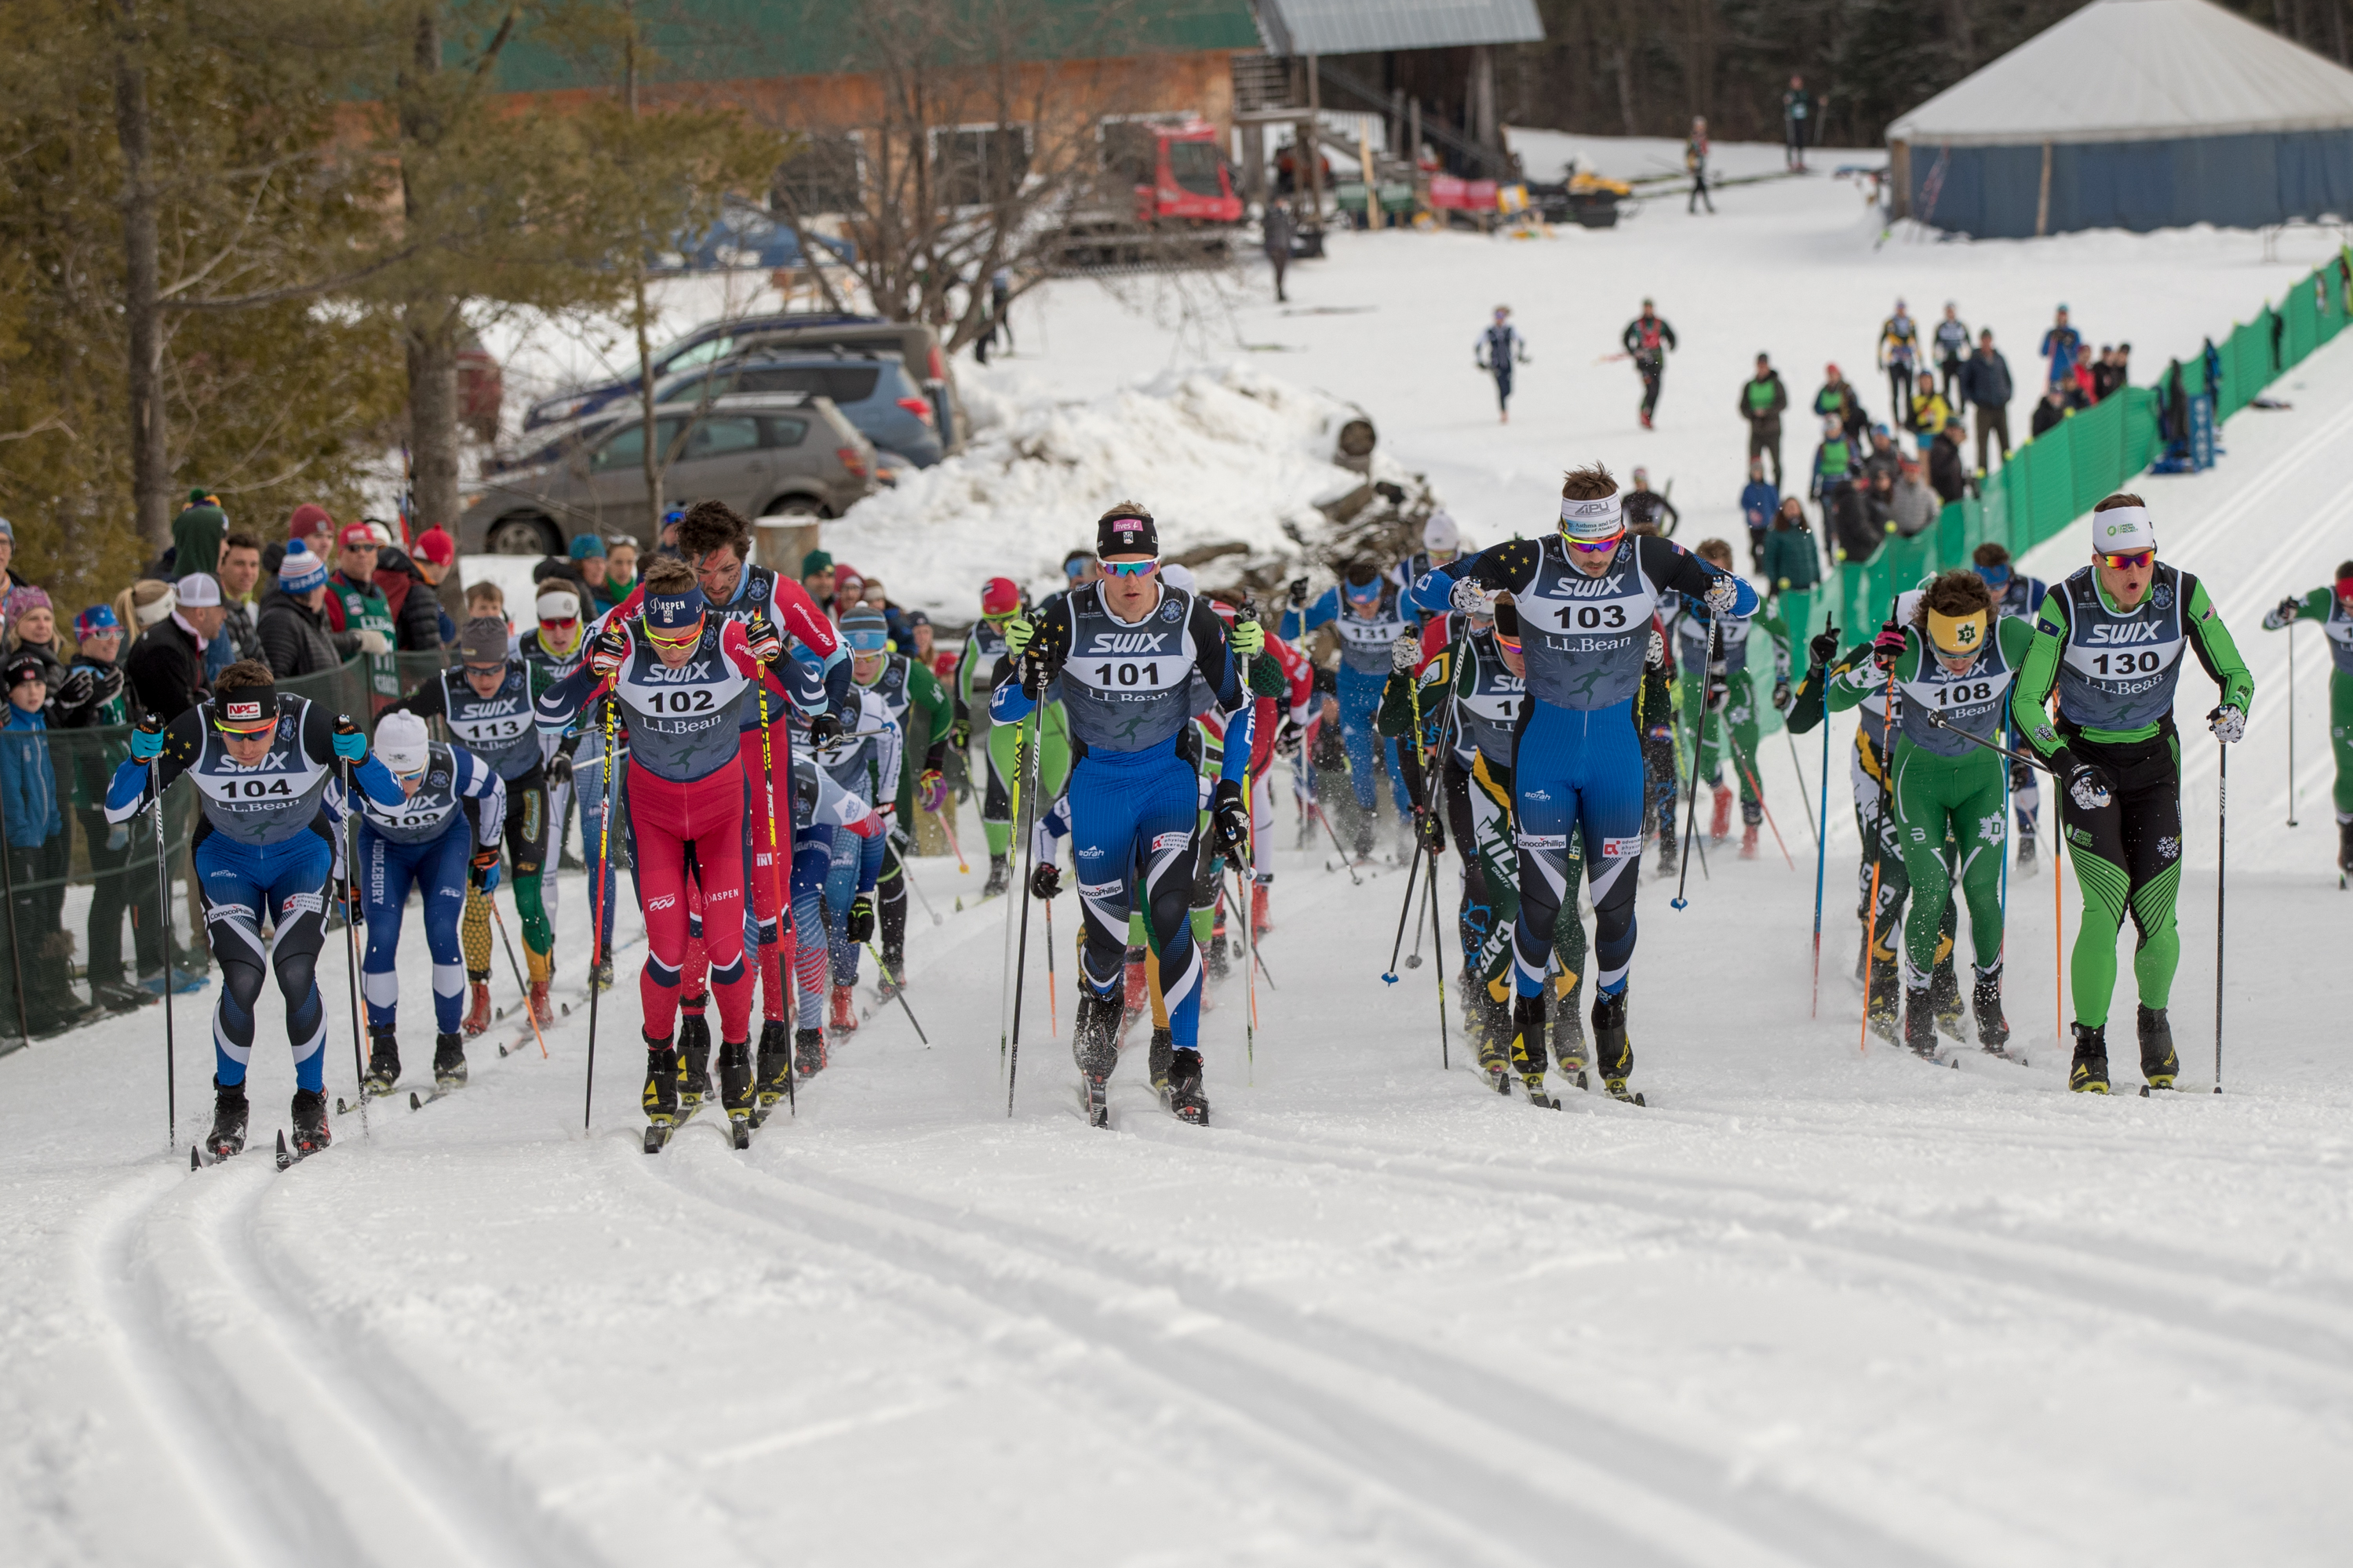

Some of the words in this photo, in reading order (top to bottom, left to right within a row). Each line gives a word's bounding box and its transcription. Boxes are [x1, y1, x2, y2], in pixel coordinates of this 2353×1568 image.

[1550, 573, 1626, 597] SWIX
[661, 600, 686, 610] ASPEN
[792, 602, 821, 635] podiumwear
[1553, 605, 1627, 629] 103
[1087, 632, 1169, 653] SWIX
[1351, 628, 1389, 639] 131
[1707, 620, 1717, 654] SWIX
[1963, 629, 1972, 638] D
[2085, 620, 2163, 644] SWIX
[1545, 635, 1632, 653] L.L.Bean
[643, 660, 712, 683] SWIX
[1095, 662, 1160, 686] 101
[1453, 641, 1467, 686] SWIX
[2092, 650, 2161, 675] 130
[1488, 675, 1527, 692] SW
[1933, 682, 1992, 706] 108
[2085, 674, 2164, 696] L.L.Bean
[228, 704, 258, 715] NAC
[459, 697, 519, 720] SWIX
[647, 689, 716, 713] 102
[759, 689, 769, 729] LEKI
[467, 721, 519, 739] 113
[606, 702, 615, 741] LEKI
[642, 715, 722, 735] L.L.Bean
[1409, 677, 1426, 766] FISCHER
[1032, 729, 1041, 780] SWIX
[220, 778, 293, 799] 104
[214, 799, 300, 813] L.L.Bean
[521, 788, 541, 842] Catamounts
[155, 796, 164, 846] SWIX
[384, 813, 441, 827] 109
[768, 817, 777, 847] SHARK
[1518, 839, 1566, 848] ConocoPhillips
[2071, 836, 2094, 849] PROJECT
[2073, 831, 2092, 844] RACING
[2074, 828, 2093, 838] GREEN
[1491, 866, 1508, 890] CRAFT
[712, 888, 739, 902] ASPEN
[296, 904, 321, 912] therapy
[1479, 919, 1517, 974] CATS
